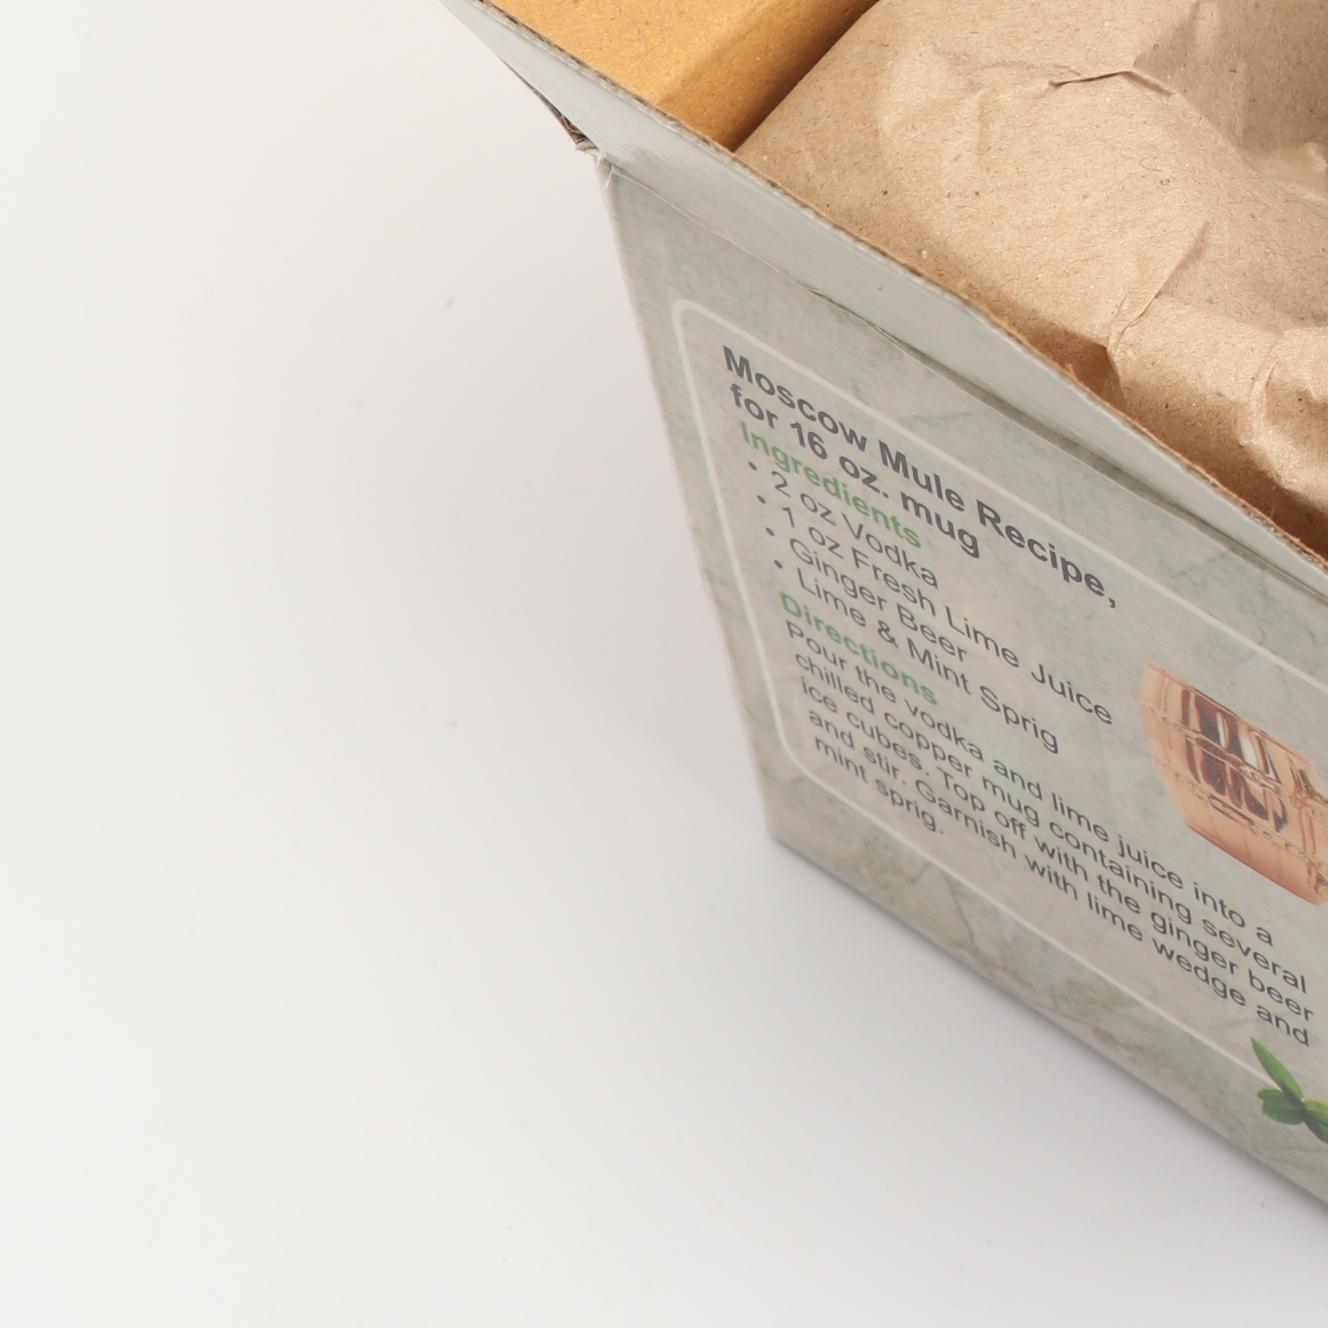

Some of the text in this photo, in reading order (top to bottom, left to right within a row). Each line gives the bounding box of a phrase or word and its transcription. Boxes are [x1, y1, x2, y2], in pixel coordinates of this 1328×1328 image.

[722, 344, 1117, 609] Moscow Mule Recipe,
[729, 383, 981, 559] for 16 oz. mug
[740, 420, 923, 550] Ingredients
[770, 470, 939, 590] 2 oz Vodka
[780, 591, 939, 706] Directions
[783, 506, 1113, 725] 1 oz Fresh Lime Juice
[789, 537, 967, 663] Ginger Beer
[797, 568, 1060, 755] Lime & Mint Sprig
[785, 619, 1274, 947] Pour the vodka and lime juice into a
[795, 652, 1308, 995] chilled copper mug containing several
[801, 676, 1315, 1023] ice cubes. Top off with the ginger beer
[815, 736, 946, 836] mint sprig.
[808, 709, 1310, 1047] and stir. Garnish with lime wedge and
